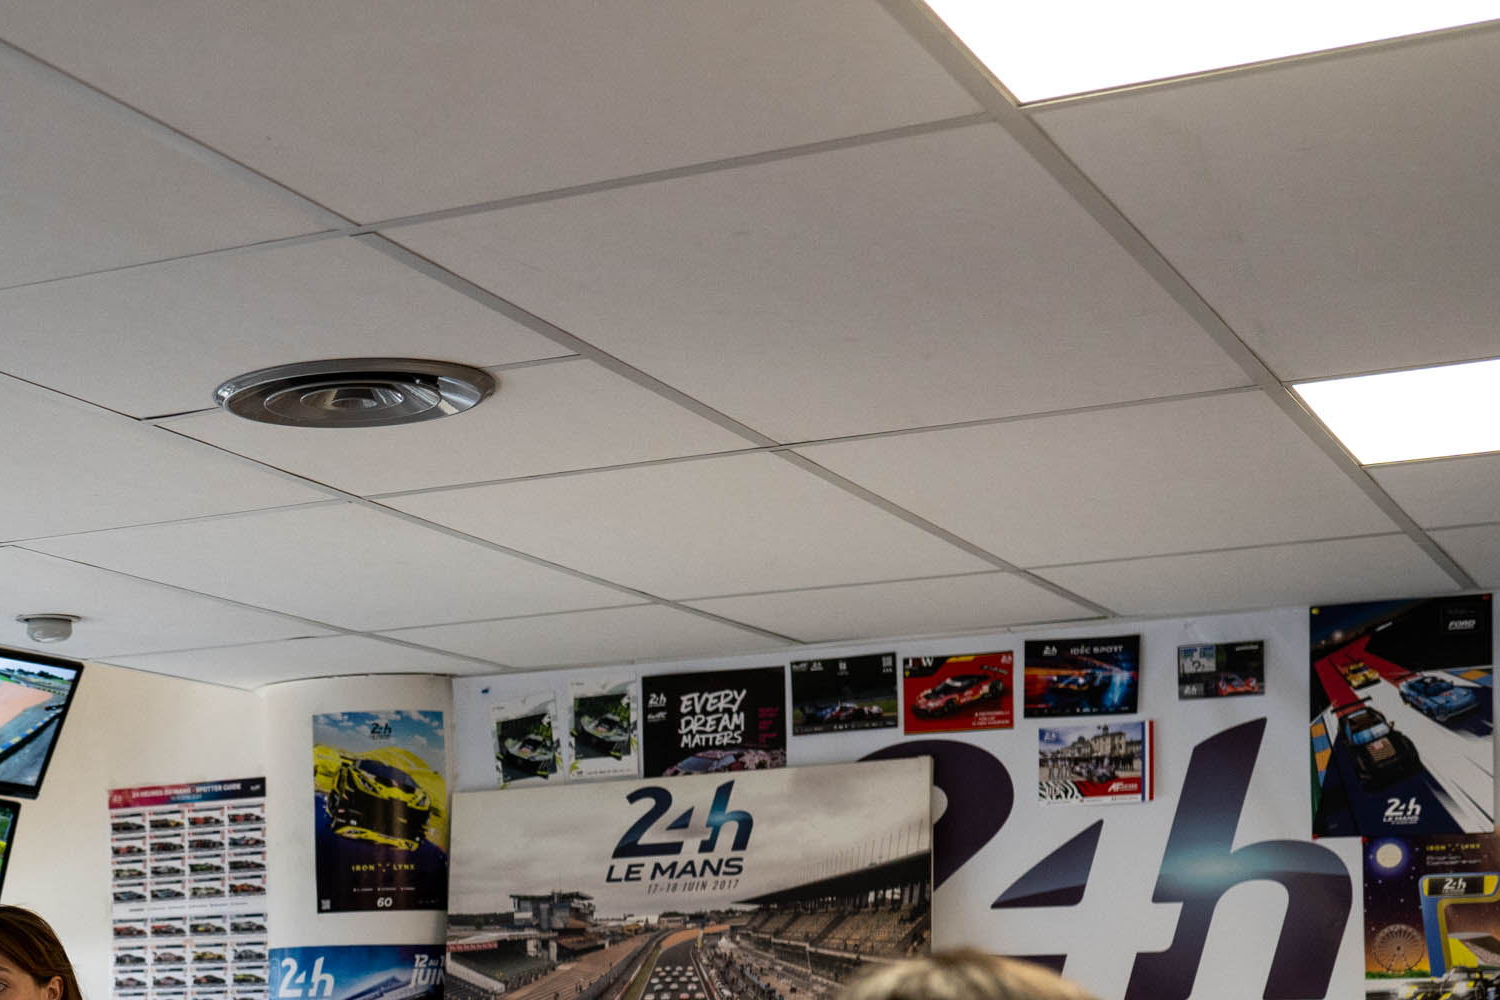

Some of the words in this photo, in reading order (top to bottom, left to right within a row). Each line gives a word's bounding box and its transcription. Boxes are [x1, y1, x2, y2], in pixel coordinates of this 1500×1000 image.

[680, 689, 747, 713] EVERY
[678, 711, 745, 735] DREAM
[680, 731, 743, 749] MATTERS
[612, 779, 754, 860] 24h
[351, 864, 375, 872] IRON
[605, 864, 645, 883] LE
[650, 857, 744, 881] MANS
[682, 881, 708, 893] JUIN
[711, 879, 740, 891] 2017
[376, 897, 393, 908] 60
[414, 954, 429, 968] 12
[278, 956, 335, 998] 24h
